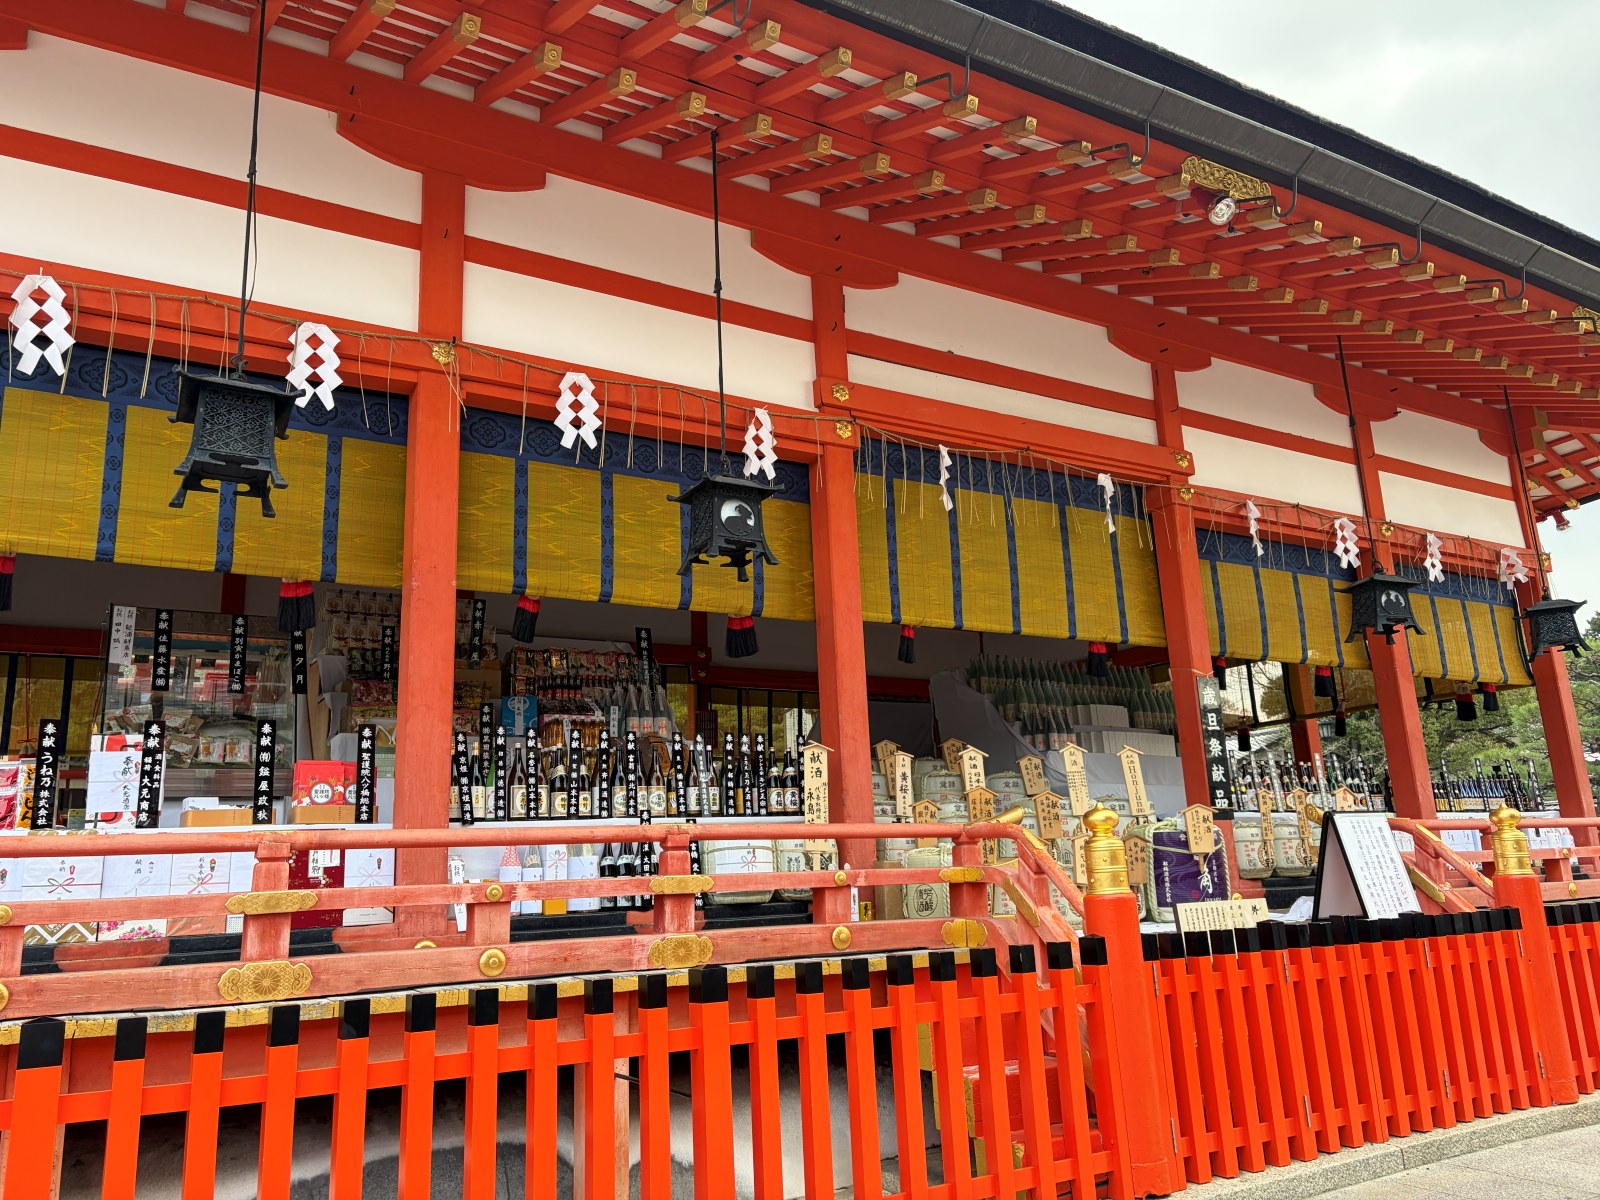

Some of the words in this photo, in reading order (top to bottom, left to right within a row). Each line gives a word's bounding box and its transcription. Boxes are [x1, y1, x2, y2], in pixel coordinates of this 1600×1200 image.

[158, 611, 169, 630] 奉献
[234, 616, 245, 635] 奉献
[42, 722, 57, 748] 奉献
[147, 723, 162, 748] 奉献
[260, 722, 272, 747] 奉献
[361, 727, 373, 750] 奉献
[456, 732, 466, 752] 奉献
[527, 728, 536, 748] 奉献
[571, 730, 580, 749] 奉献
[600, 730, 609, 749] 奉献
[627, 732, 636, 751] 奉献
[673, 733, 682, 751] 奉献
[725, 733, 734, 751] 奉献
[741, 734, 750, 752] 奉献
[756, 734, 765, 752] 奉献
[1202, 686, 1230, 807] 歳旦祭献品
[810, 750, 823, 779] 献酒
[36, 789, 51, 825] 株式会社
[134, 858, 143, 875] 献酒
